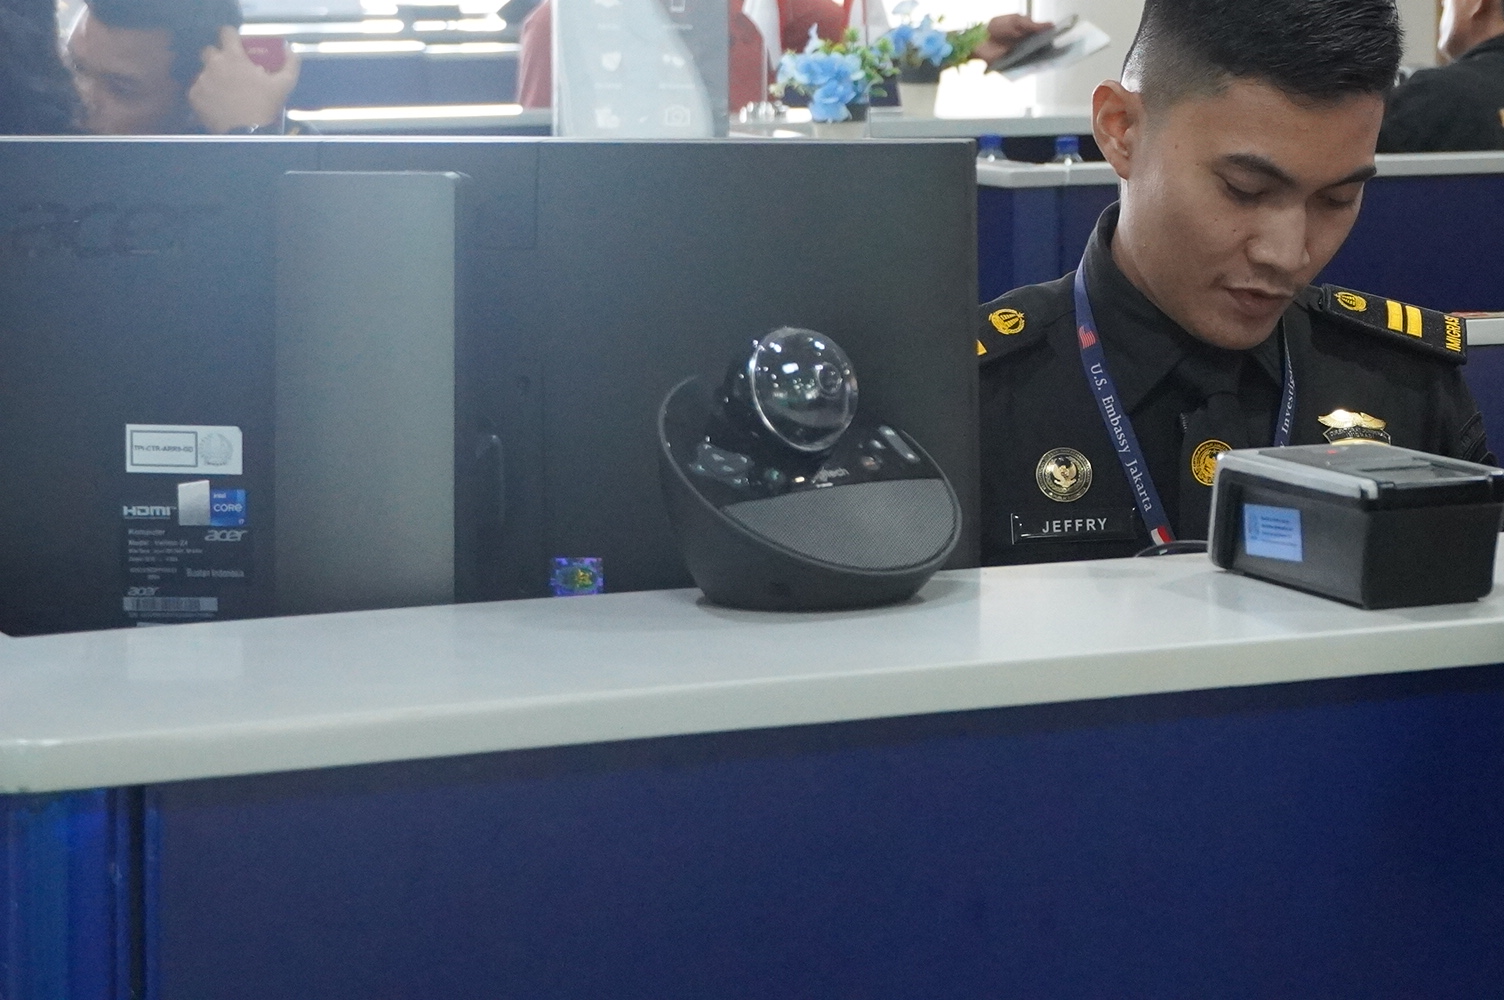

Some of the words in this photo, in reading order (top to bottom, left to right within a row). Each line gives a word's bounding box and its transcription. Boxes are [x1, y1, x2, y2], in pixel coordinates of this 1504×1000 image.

[1090, 362, 1108, 391] U.S.
[1102, 395, 1131, 454] Embassy
[1125, 459, 1153, 512] Jakarta
[122, 505, 171, 516] HDMI
[1042, 517, 1107, 533] JEFFRY
[204, 529, 248, 542] acer
